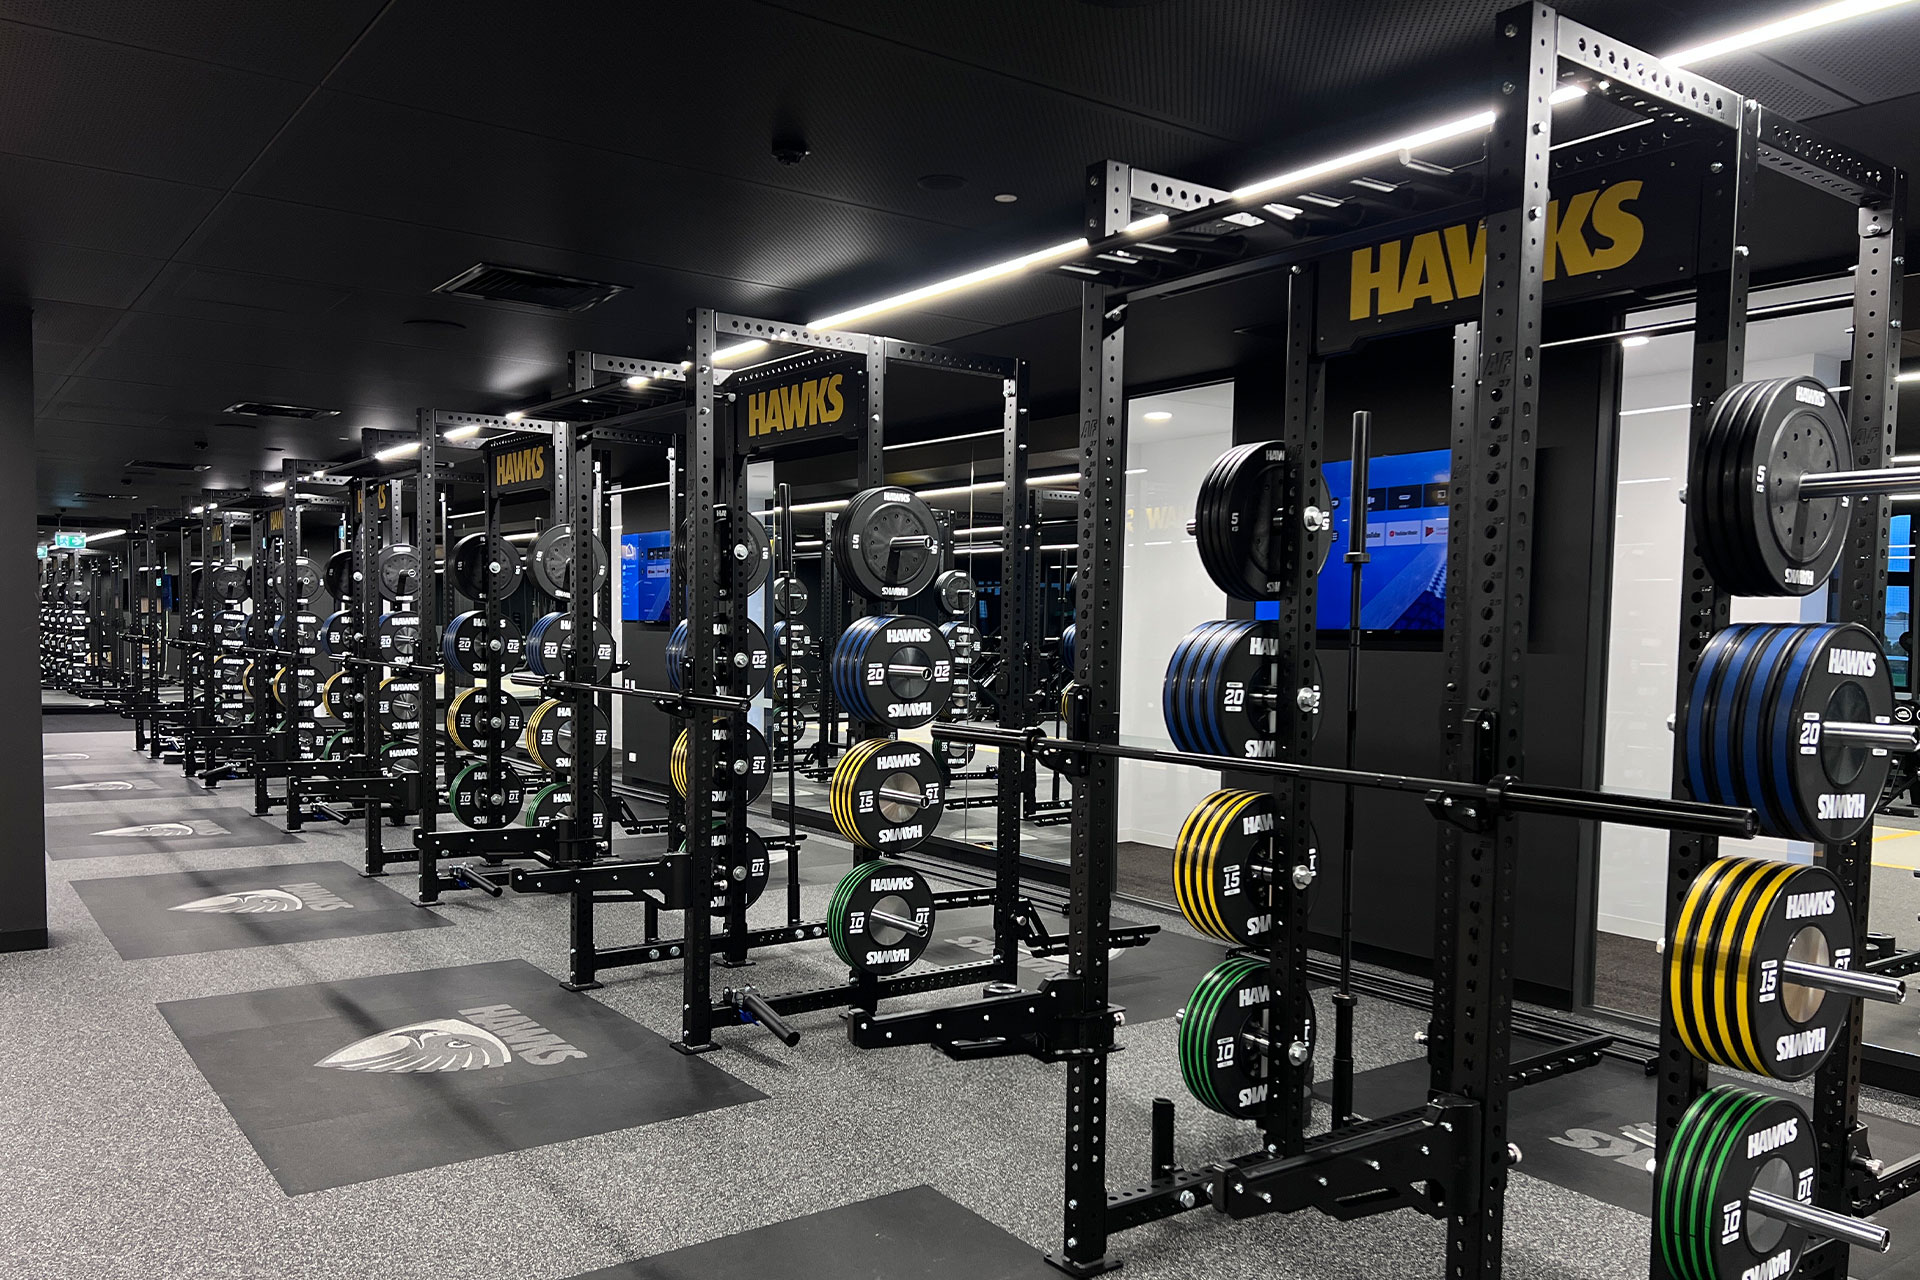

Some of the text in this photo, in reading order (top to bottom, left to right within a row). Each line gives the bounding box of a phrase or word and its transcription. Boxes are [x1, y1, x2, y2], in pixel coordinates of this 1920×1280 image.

[1796, 386, 1825, 406] HAWKS
[748, 374, 843, 437] HAWKS
[496, 446, 544, 486] HAWKS
[1757, 465, 1766, 482] 5
[884, 492, 910, 504] HAWKS
[1230, 512, 1239, 525] 5
[851, 534, 860, 544] 5
[1785, 569, 1814, 585] HAWKS
[882, 587, 908, 596] HAWKS
[887, 629, 931, 642] HAWKS
[458, 641, 471, 649] 20
[543, 646, 558, 655] 20
[1249, 636, 1279, 656] HAW
[752, 655, 767, 665] 20
[1828, 648, 1876, 676] HAWKS
[865, 669, 886, 683] 20
[932, 667, 952, 679] 20
[1223, 688, 1245, 705] 20
[888, 702, 931, 717] HAWKS
[540, 734, 553, 742] 15
[594, 734, 606, 742] 15
[1800, 723, 1820, 744] 20
[752, 761, 765, 770] 15
[877, 753, 920, 769] HAWKS
[858, 794, 875, 810] 15
[1818, 794, 1865, 819] HAWKS
[1242, 813, 1274, 836] HAW
[879, 825, 922, 843] HAWKS
[751, 863, 764, 873] 10
[871, 877, 913, 891] HAWKS
[1223, 871, 1240, 890] 15
[1786, 891, 1835, 919] HAWKS
[848, 918, 866, 931] 10
[866, 949, 909, 964] HAWKS
[1757, 968, 1778, 994] 15
[1238, 984, 1270, 1009] HAW
[1776, 1028, 1825, 1061] HAWKS
[1216, 1044, 1234, 1062] 10
[1747, 1118, 1798, 1159] HAWKS
[1797, 1176, 1813, 1201] 10
[1721, 1208, 1741, 1236] 10
